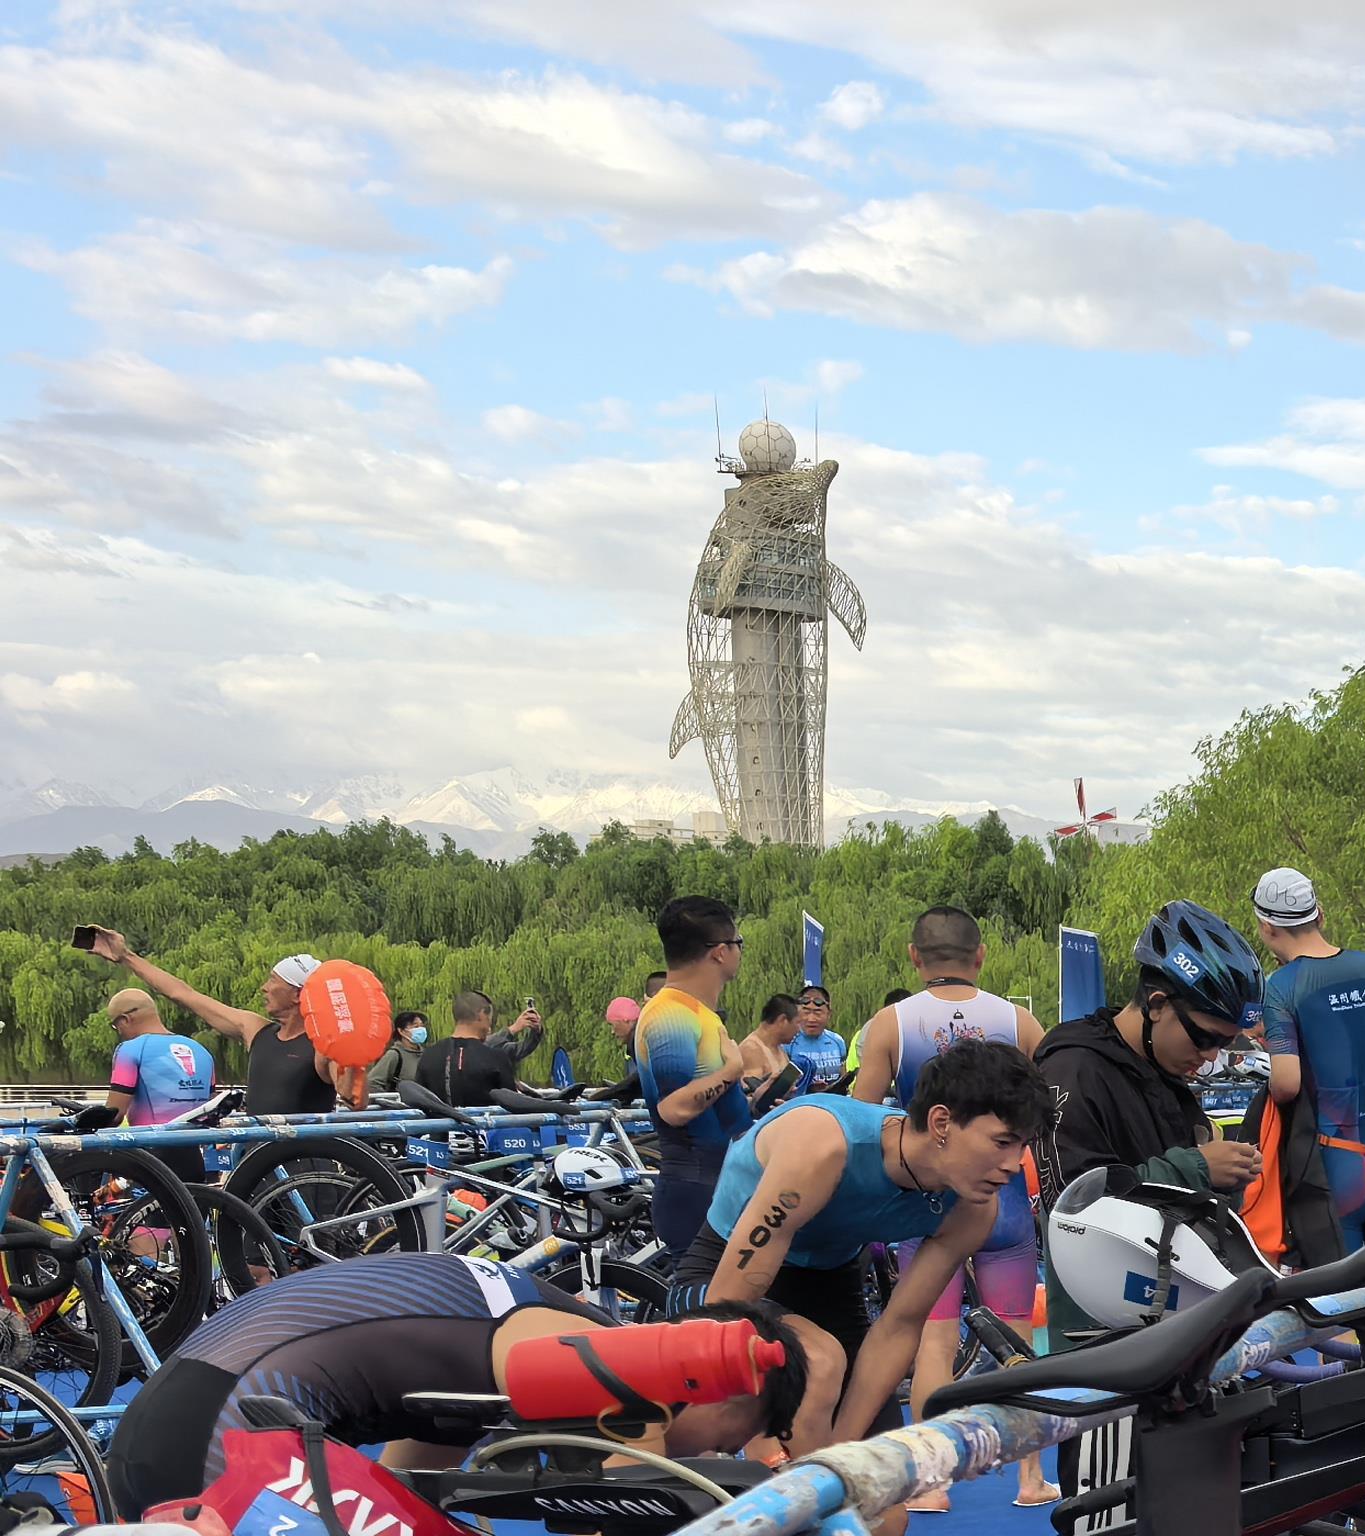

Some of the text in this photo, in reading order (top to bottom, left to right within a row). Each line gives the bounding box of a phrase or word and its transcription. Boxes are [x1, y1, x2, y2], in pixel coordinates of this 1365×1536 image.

[1172, 952, 1200, 979] 302
[504, 1138, 526, 1149] 520
[408, 1144, 430, 1157] 521
[566, 1176, 584, 1186] 521
[534, 1496, 678, 1517] CANYON
